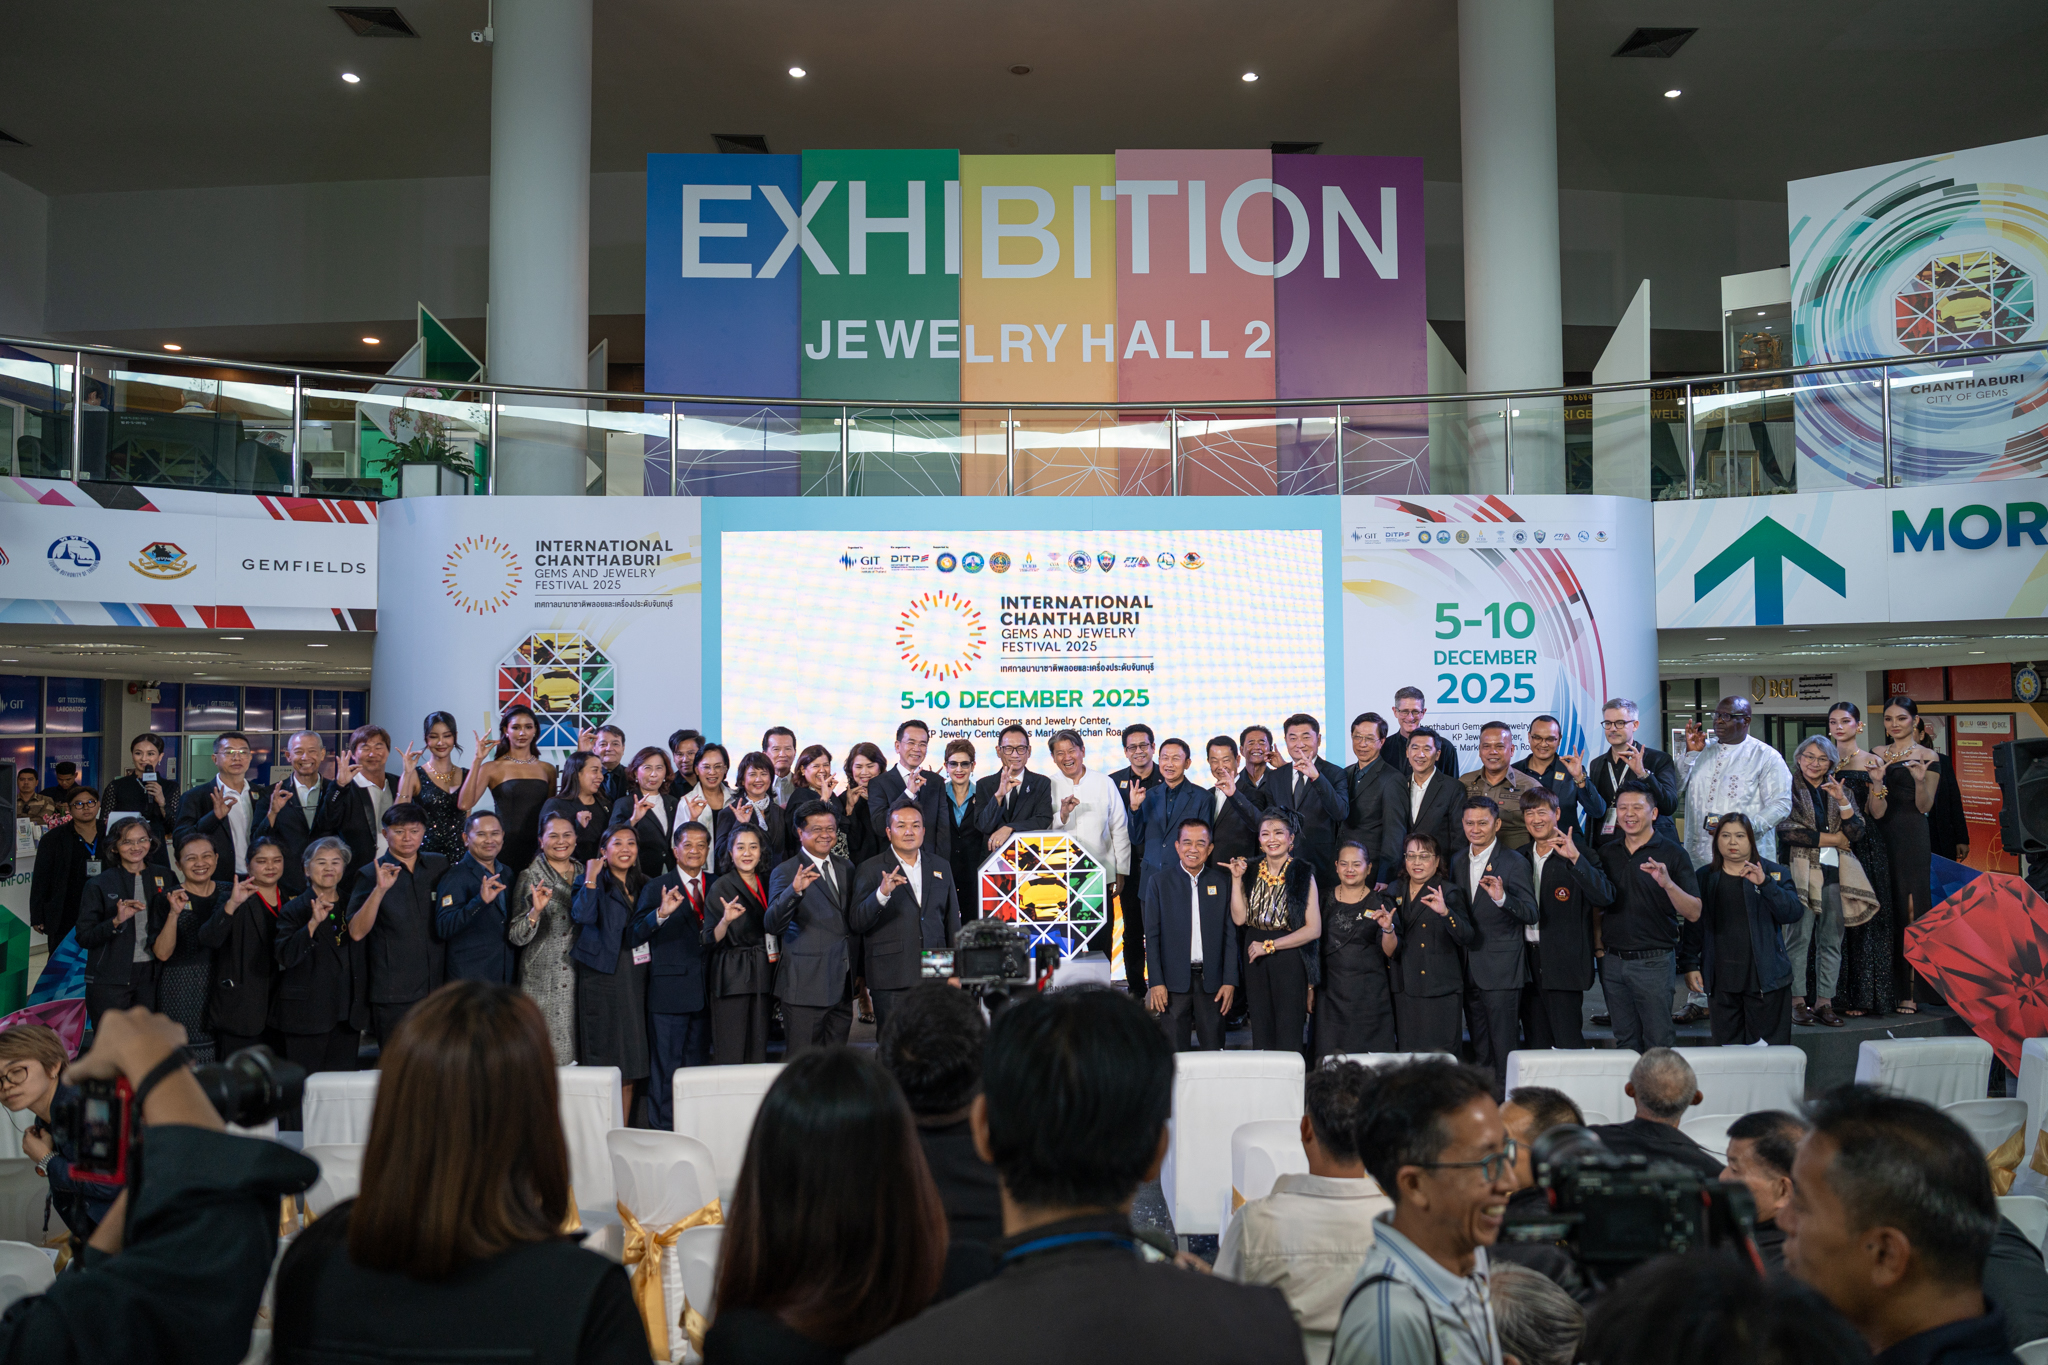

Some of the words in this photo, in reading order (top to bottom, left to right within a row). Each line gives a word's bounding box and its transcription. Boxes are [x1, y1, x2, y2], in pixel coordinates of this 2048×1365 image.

[682, 178, 1399, 280] EXHIBITION
[805, 319, 1068, 363] JEWELRY
[1082, 319, 1229, 363] HALL
[1244, 320, 1272, 359] 2
[1911, 373, 2025, 395] CHANTHABURI
[1926, 394, 1953, 405] CITY
[1956, 392, 1972, 402] OF
[1976, 388, 2009, 400] GEMS
[535, 539, 674, 552] INTERNATIONAL
[242, 558, 367, 575] GEMFIELDS
[534, 554, 661, 567] CHANTHABURI
[861, 556, 881, 566] GIT
[534, 568, 568, 579] GEMS
[572, 568, 599, 578] AND
[603, 568, 657, 578] JEWELRY
[535, 580, 589, 590] FESTIVAL
[593, 580, 622, 590] 2025
[1000, 595, 1154, 610] INTERNATIONAL
[1000, 611, 1140, 626] CHANTHABURI
[1435, 601, 1536, 640] 5-10
[1001, 628, 1039, 640] GEMS
[1043, 628, 1073, 639] AND
[1077, 627, 1136, 639] JEWELRY
[1002, 641, 1062, 653] FESTIVAL
[1066, 640, 1098, 652] 2025
[1434, 650, 1537, 666] DECEMBER
[1436, 672, 1536, 704] 2025
[1768, 678, 1798, 699] BGL
[1891, 682, 1909, 694] BGL
[9, 699, 25, 709] GIT
[900, 690, 951, 709] 5-10
[959, 689, 1084, 709] DECEMBER
[1092, 688, 1151, 708] 2025
[940, 716, 995, 727] Chanthaburi
[997, 716, 1023, 727] Gems
[1025, 716, 1042, 726] and
[1044, 715, 1077, 727] Jewelry
[1079, 715, 1112, 726] Center,
[939, 729, 972, 740] Jewelry
[974, 729, 1000, 739] Cente
[1452, 733, 1463, 741] KP
